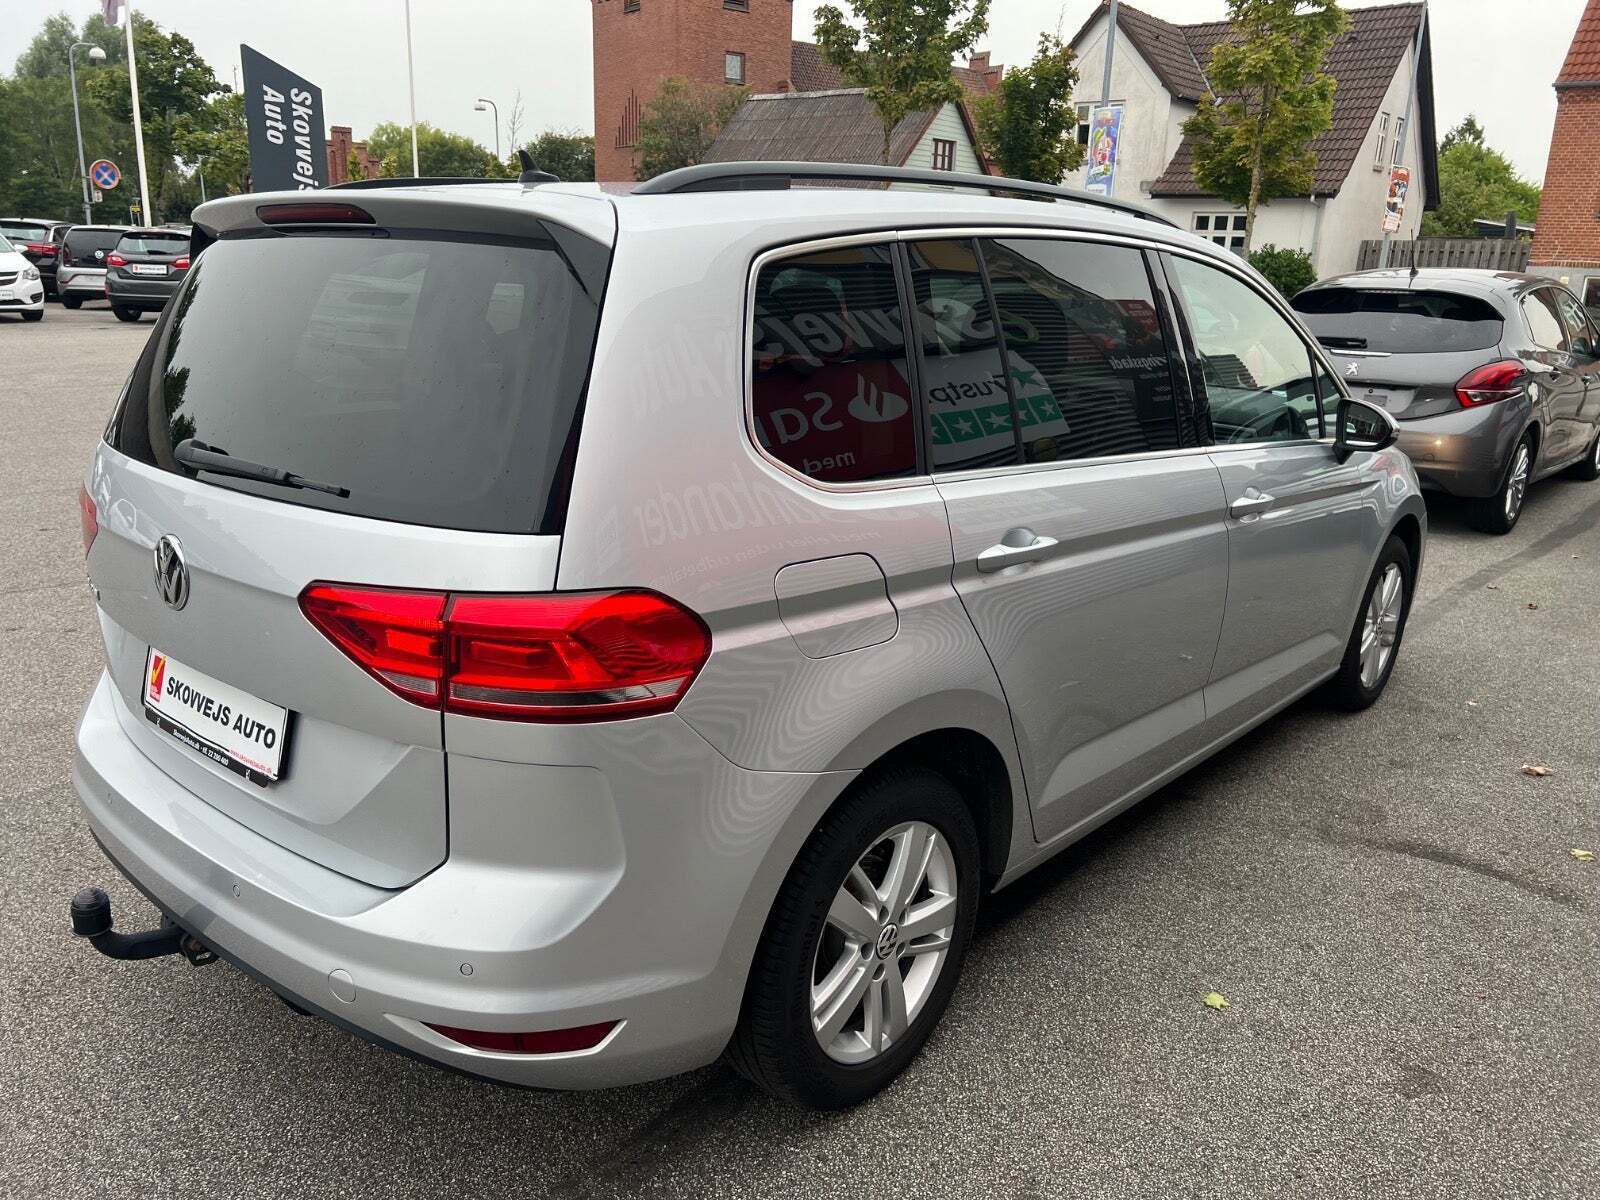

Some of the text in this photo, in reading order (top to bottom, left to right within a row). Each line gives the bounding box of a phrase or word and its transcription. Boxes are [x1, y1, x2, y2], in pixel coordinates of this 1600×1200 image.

[262, 84, 287, 145] Auto
[166, 676, 276, 749] SKOVVEJS AUTO
